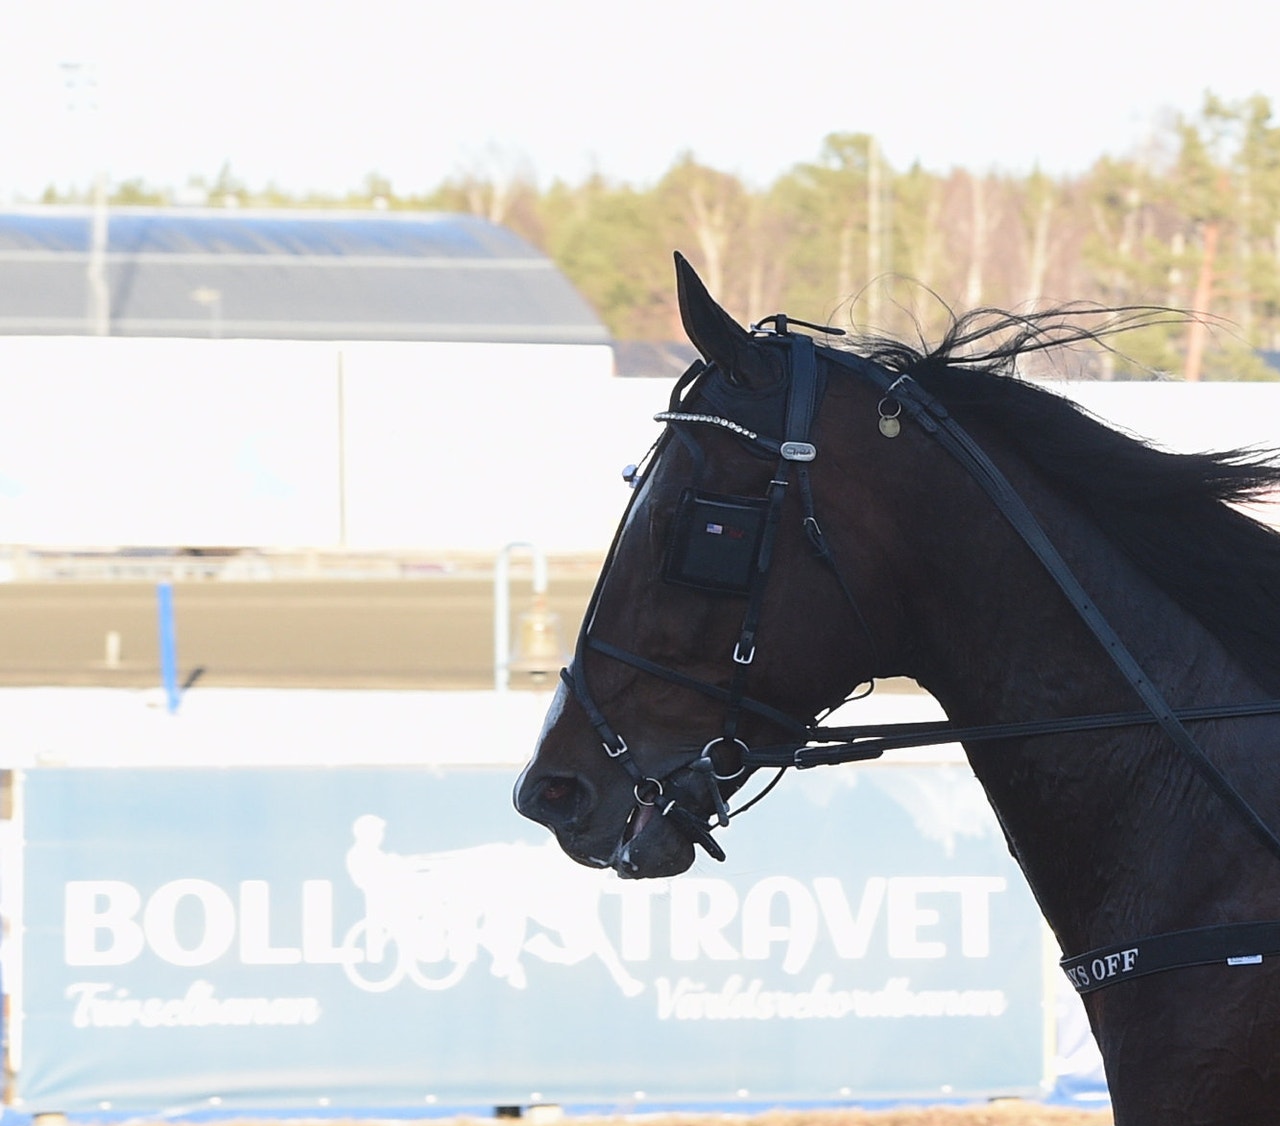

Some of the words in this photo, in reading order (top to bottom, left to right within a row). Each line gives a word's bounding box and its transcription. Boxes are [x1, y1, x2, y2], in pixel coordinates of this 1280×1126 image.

[65, 877, 1006, 974] BOLLTRAVET
[1067, 965, 1090, 988] YS
[1092, 948, 1138, 980] OFF
